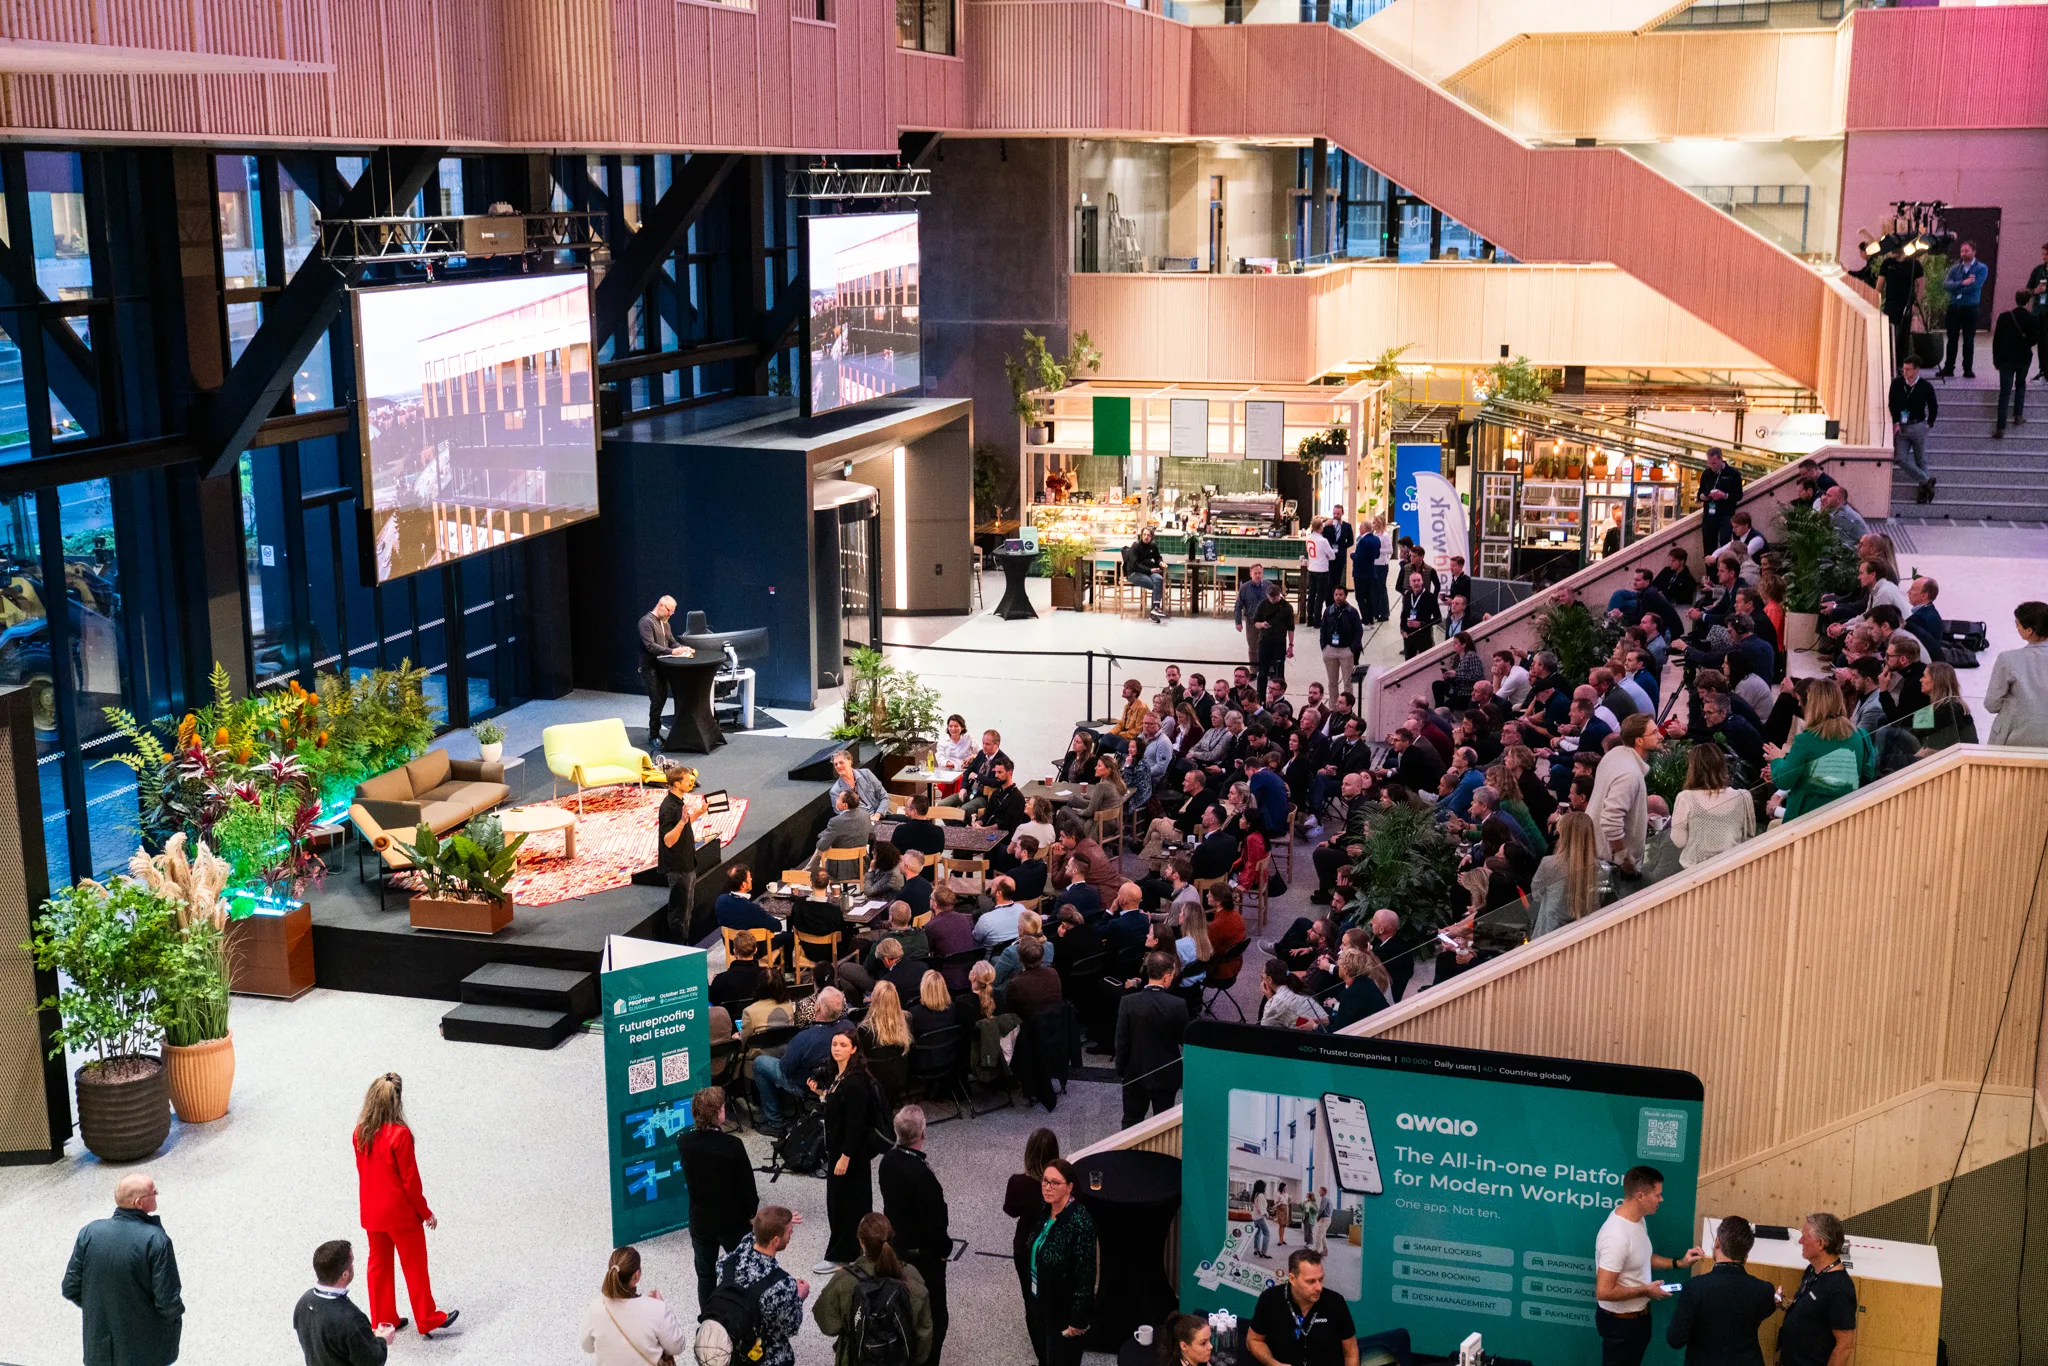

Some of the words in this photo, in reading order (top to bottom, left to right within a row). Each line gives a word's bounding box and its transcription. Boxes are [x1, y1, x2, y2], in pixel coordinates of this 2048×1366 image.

[1402, 502, 1419, 511] OB
[628, 993, 641, 1001] OSLO
[628, 996, 656, 1007] PROPTECH
[660, 990, 678, 999] October
[628, 1003, 648, 1012] SUMMIT
[619, 1008, 695, 1034] Futureproofing
[629, 1030, 652, 1044] Real
[654, 1023, 686, 1038] Estate
[1319, 1047, 1348, 1057] Trusted
[1349, 1051, 1391, 1062] companies
[1434, 1060, 1454, 1070] Daily
[1455, 1063, 1476, 1071] users
[1499, 1067, 1538, 1078] Countries
[1539, 1071, 1572, 1082] globally
[1396, 1112, 1478, 1137] awaio
[1394, 1145, 1434, 1165] The
[1439, 1151, 1548, 1177] All-in-one
[1554, 1163, 1625, 1187] Platfor
[1394, 1169, 1423, 1187] for
[1430, 1173, 1513, 1197] Modern
[1520, 1183, 1624, 1209] Workplac
[1395, 1198, 1420, 1210] One
[1423, 1203, 1449, 1213] app.
[1453, 1205, 1475, 1217] Not
[1477, 1208, 1501, 1219] ten.
[1413, 1243, 1442, 1253] SMART
[1444, 1247, 1482, 1258] LOCKERS
[1547, 1260, 1585, 1271] PARKING
[1413, 1268, 1439, 1277] ROOM
[1441, 1272, 1480, 1282] BOOKING
[1546, 1285, 1572, 1294] DOOR
[1573, 1289, 1596, 1297] ACCE
[1412, 1292, 1434, 1301] DESK
[1436, 1296, 1496, 1309] MANAGEMENT
[1545, 1310, 1590, 1321] PAYMENTS
